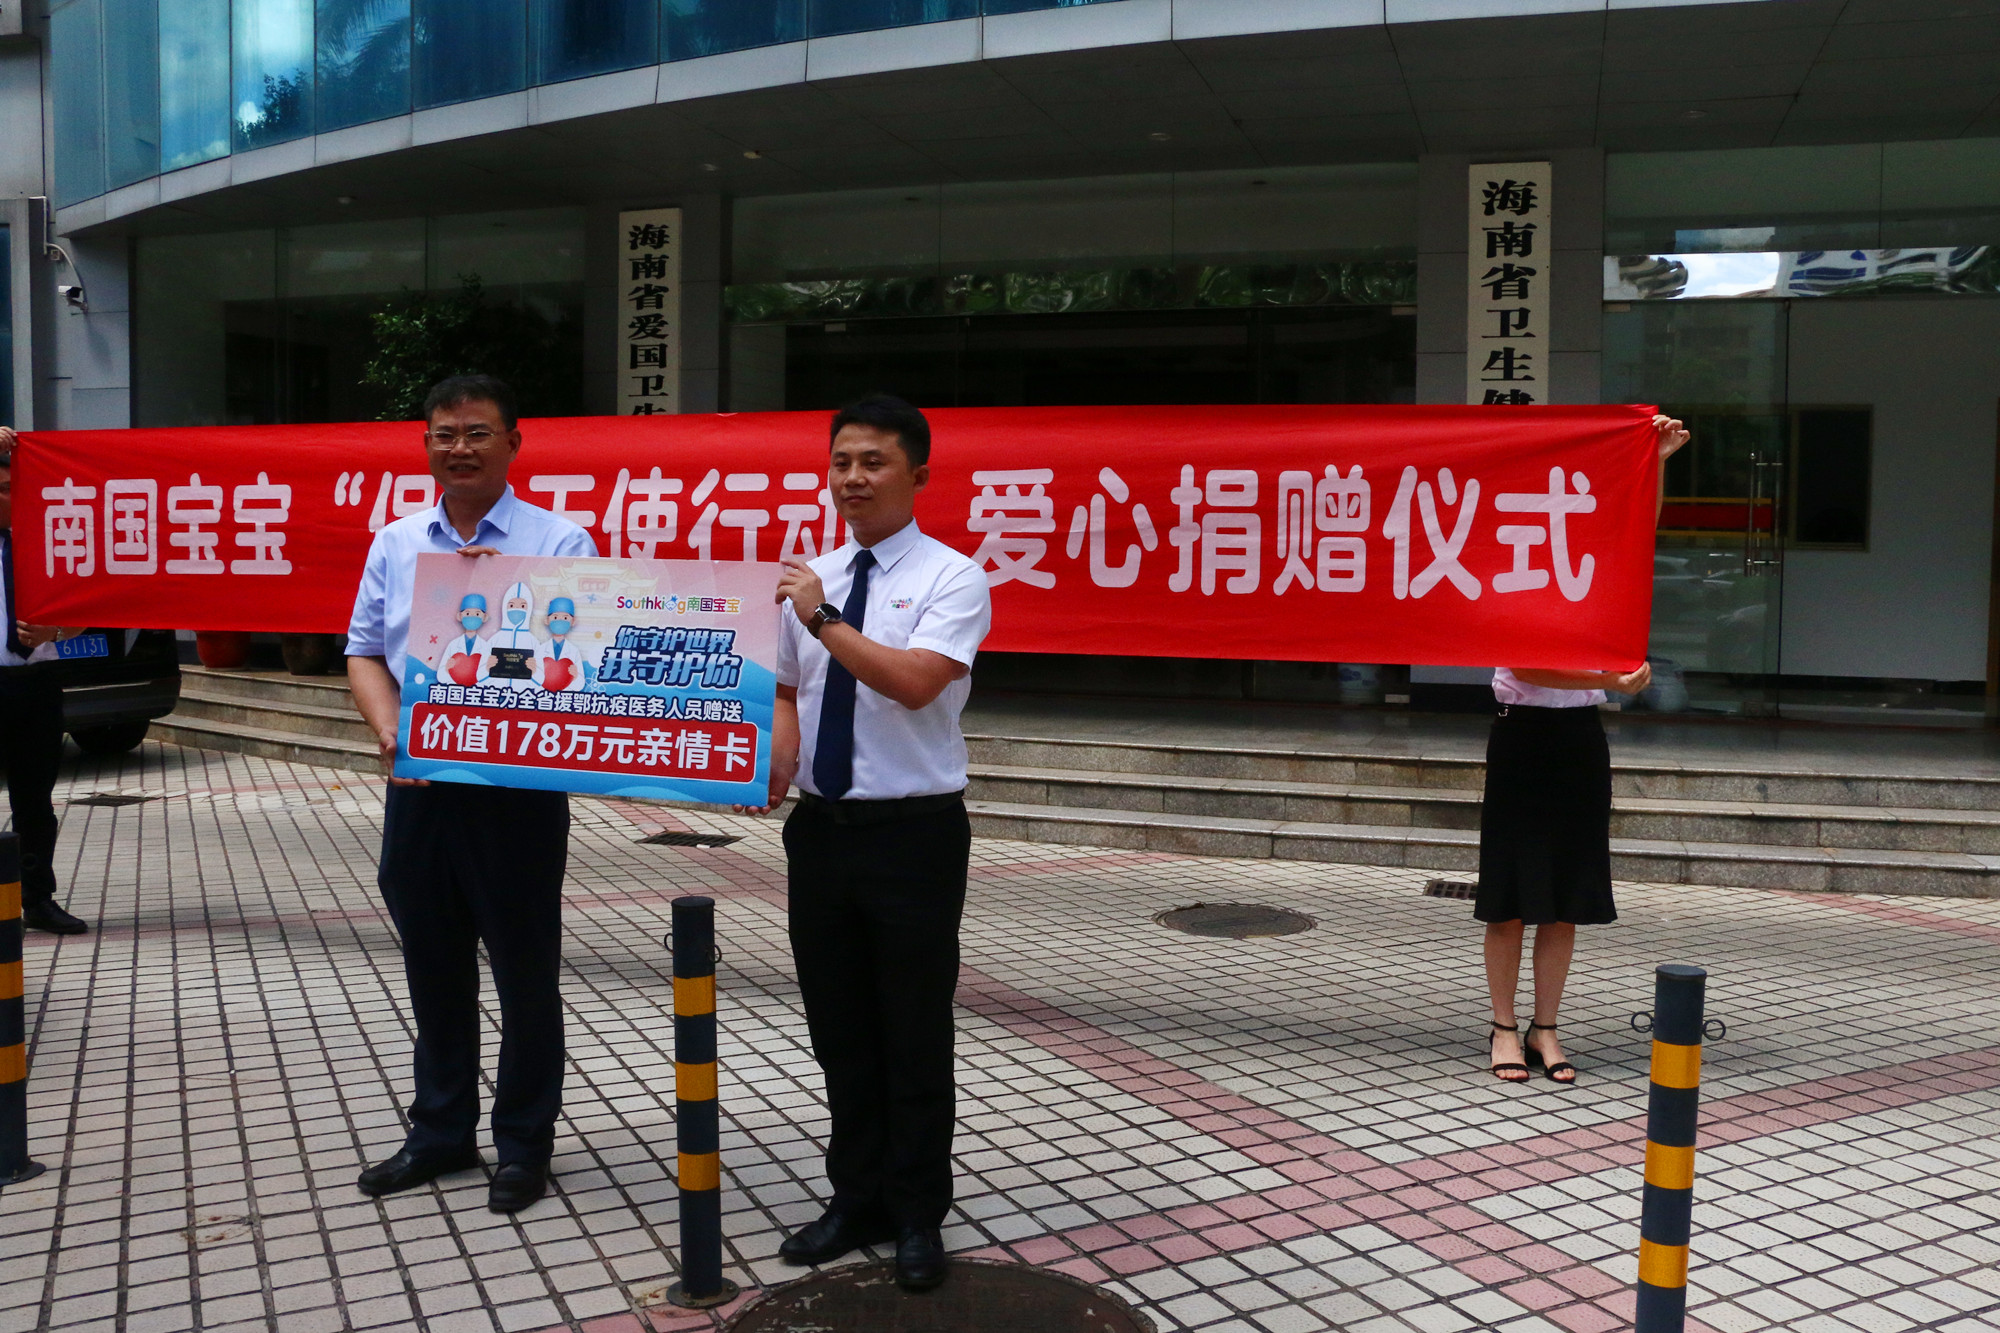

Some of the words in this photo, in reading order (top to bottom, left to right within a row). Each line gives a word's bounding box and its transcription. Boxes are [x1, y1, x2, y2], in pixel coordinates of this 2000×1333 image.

[41, 471, 293, 578] 南国宝宝
[966, 463, 1598, 602] 爱心捐赠仪式
[687, 596, 741, 613] 南国宝宝
[615, 626, 735, 653] 你守护世界
[598, 648, 742, 687] 我守护你
[428, 684, 743, 723] 南国宝宝为全省援鄂抗疫医务人员赠送
[421, 712, 750, 772] 价值178万元亲情卡
